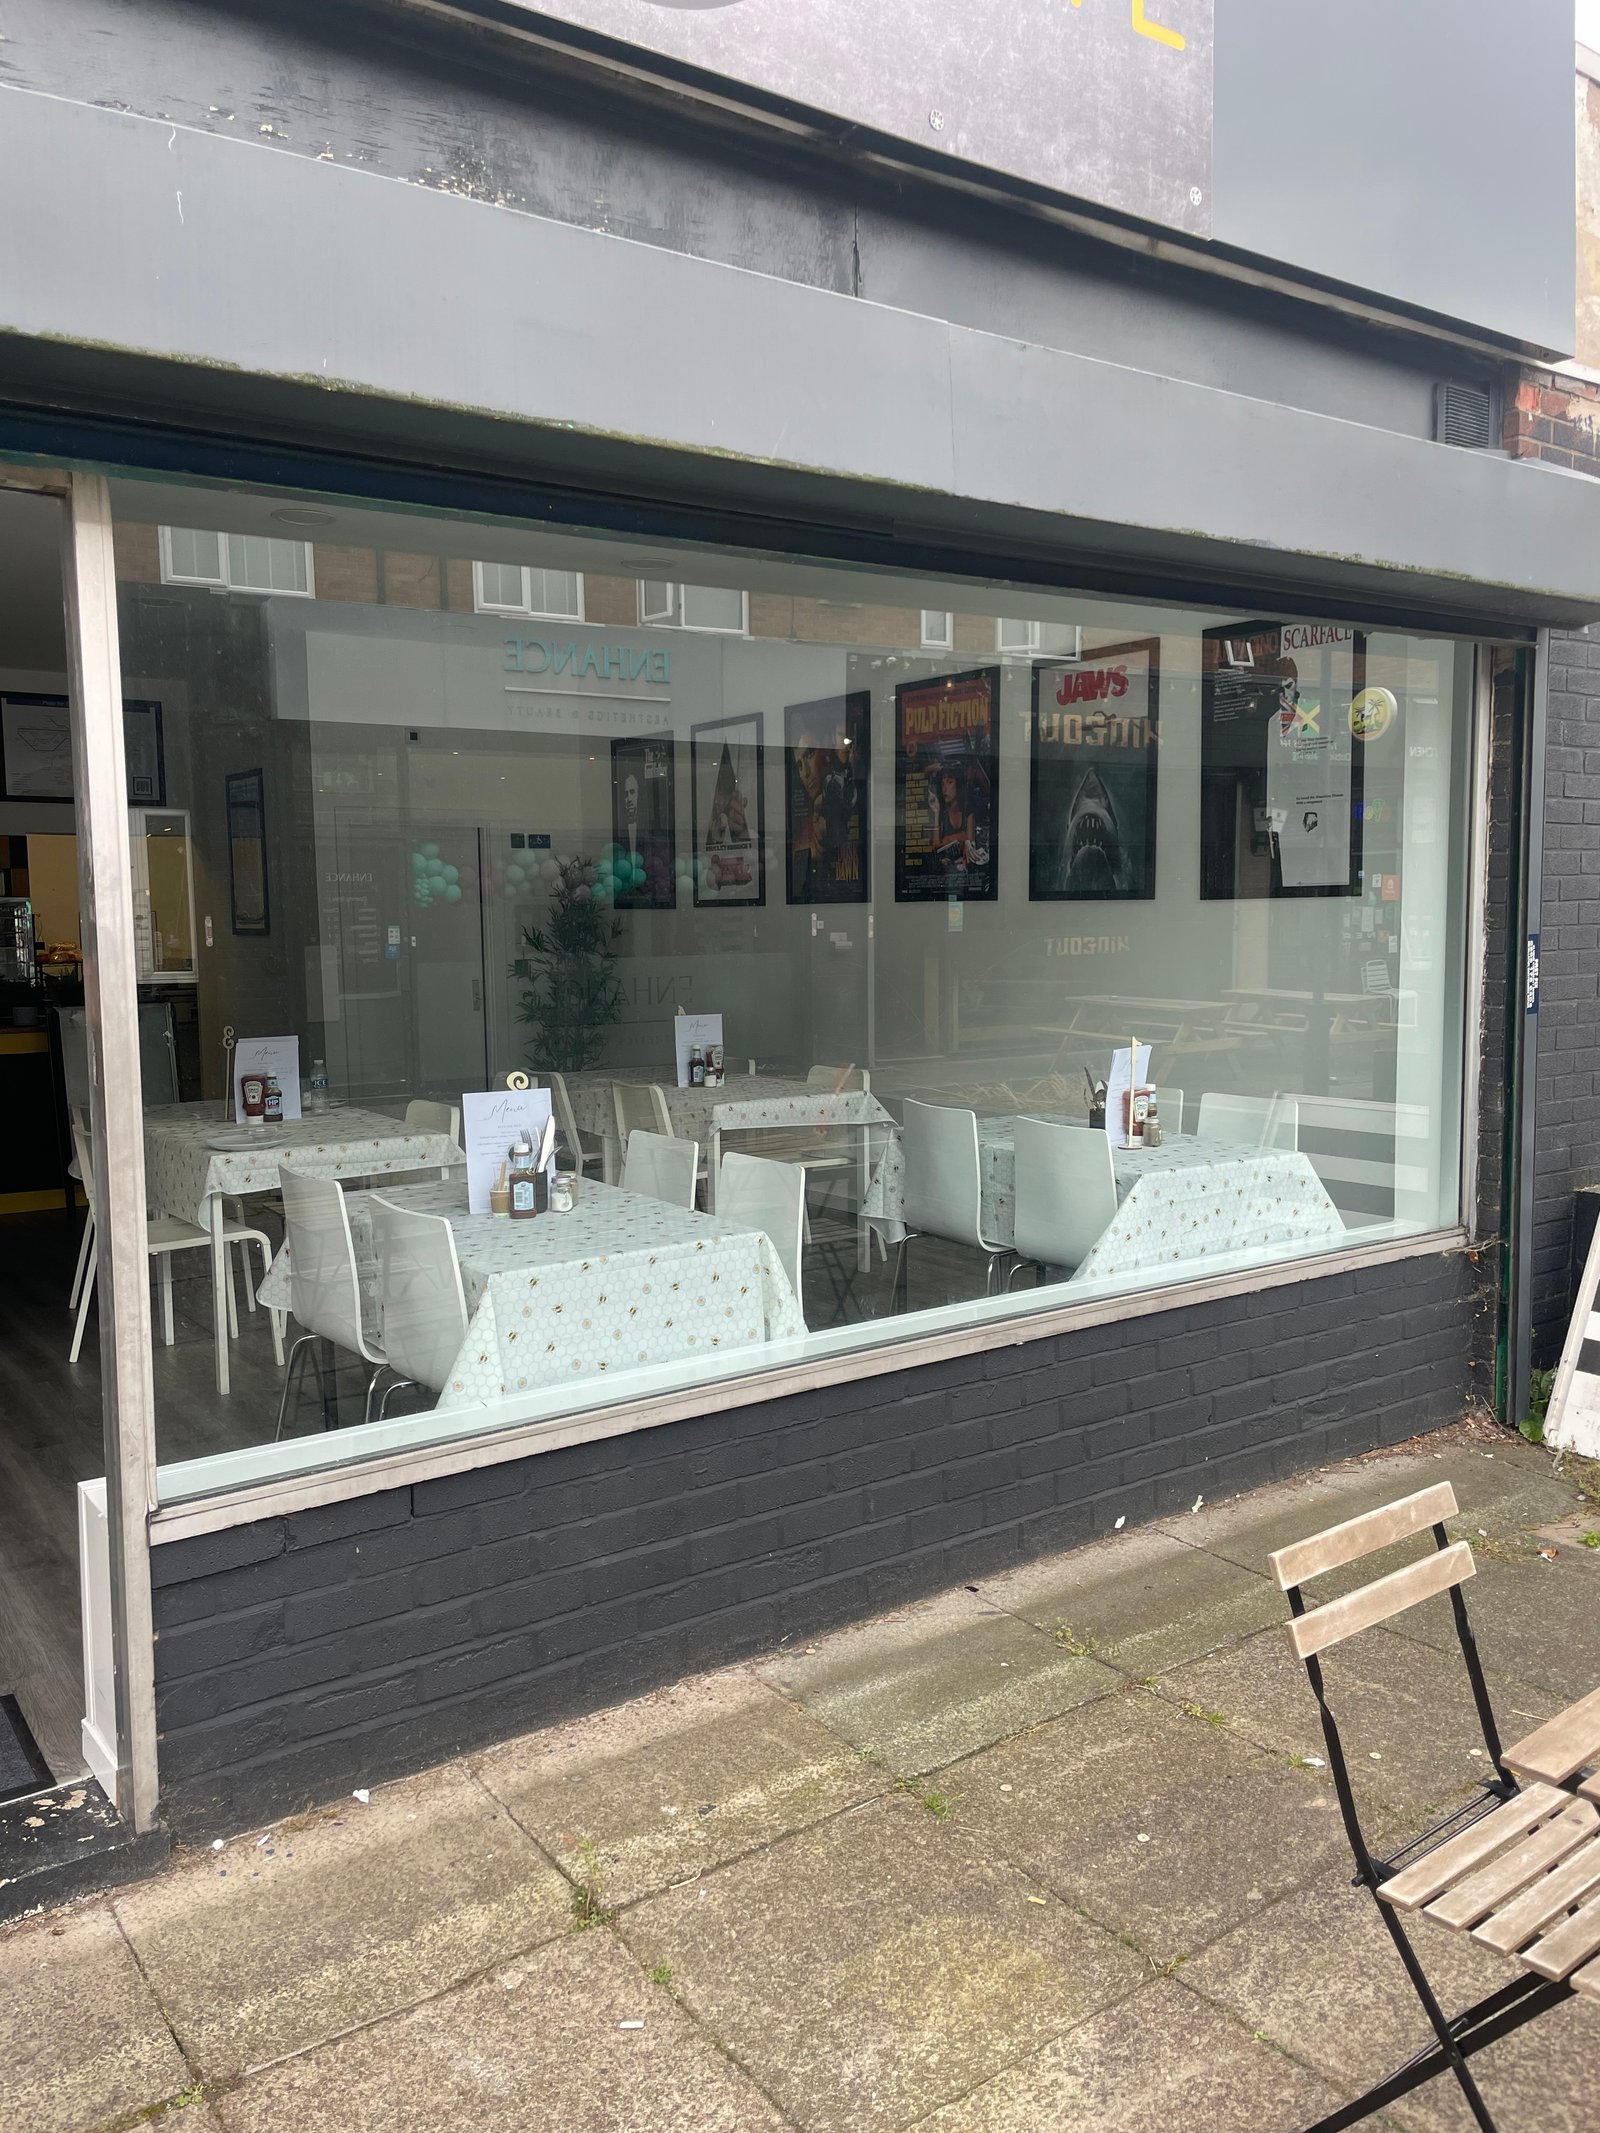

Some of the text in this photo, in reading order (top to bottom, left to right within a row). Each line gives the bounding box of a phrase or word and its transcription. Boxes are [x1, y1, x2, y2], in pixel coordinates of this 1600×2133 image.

[1283, 624, 1353, 651] SCARFACE
[1056, 665, 1129, 706] JAWS
[905, 697, 988, 735] PULP FICTION
[835, 862, 859, 882] DAWN
[489, 1098, 528, 1122] Menu
